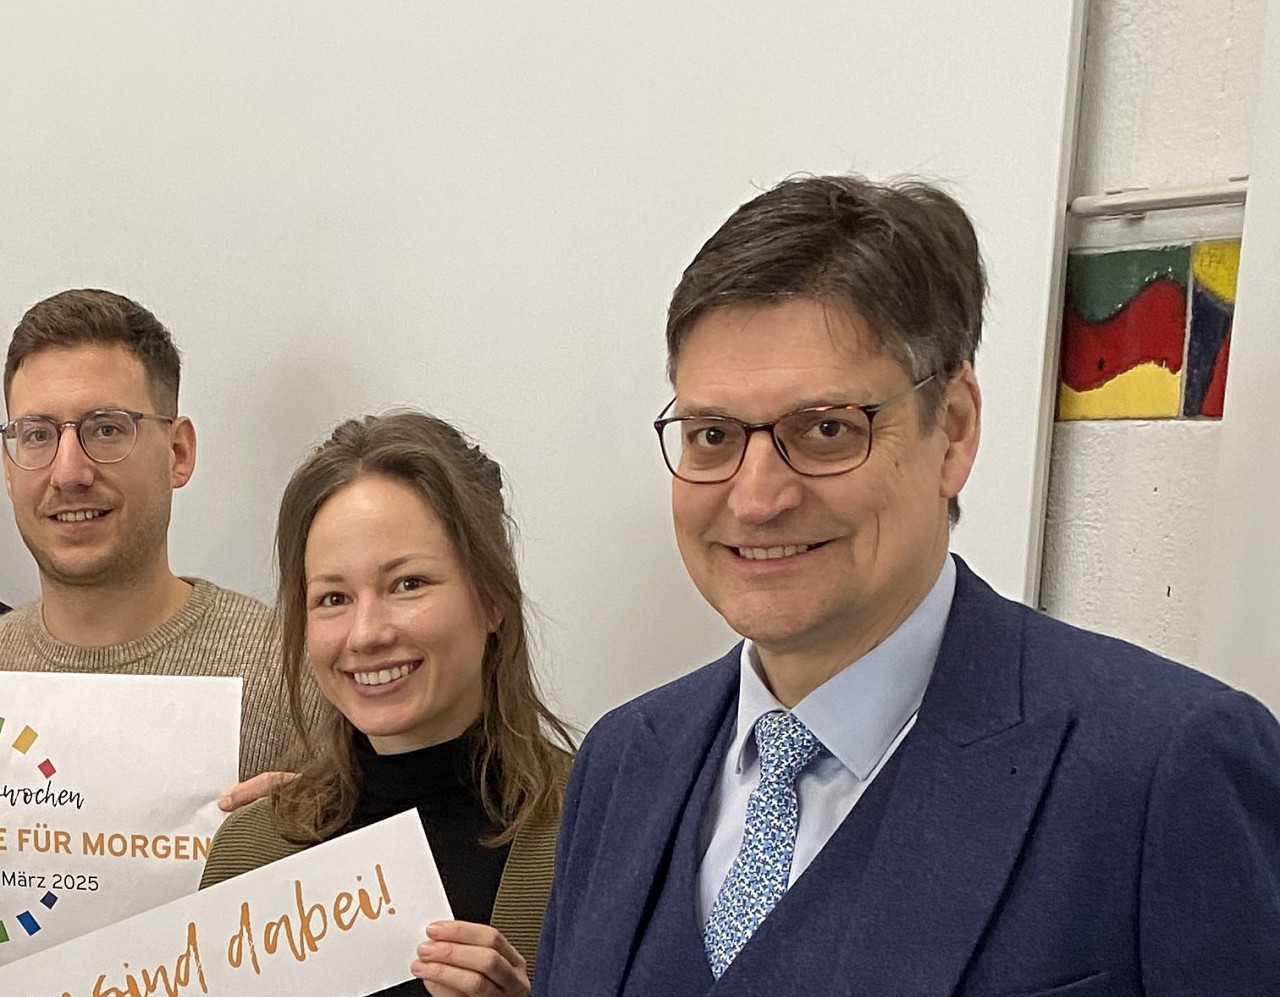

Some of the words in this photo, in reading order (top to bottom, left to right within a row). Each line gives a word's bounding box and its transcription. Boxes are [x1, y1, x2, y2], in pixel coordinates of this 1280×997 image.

[18, 823, 71, 855] FÜR
[83, 832, 211, 861] MORGEN
[2, 871, 46, 889] März
[52, 874, 99, 891] 2025
[227, 864, 396, 975] dabei!
